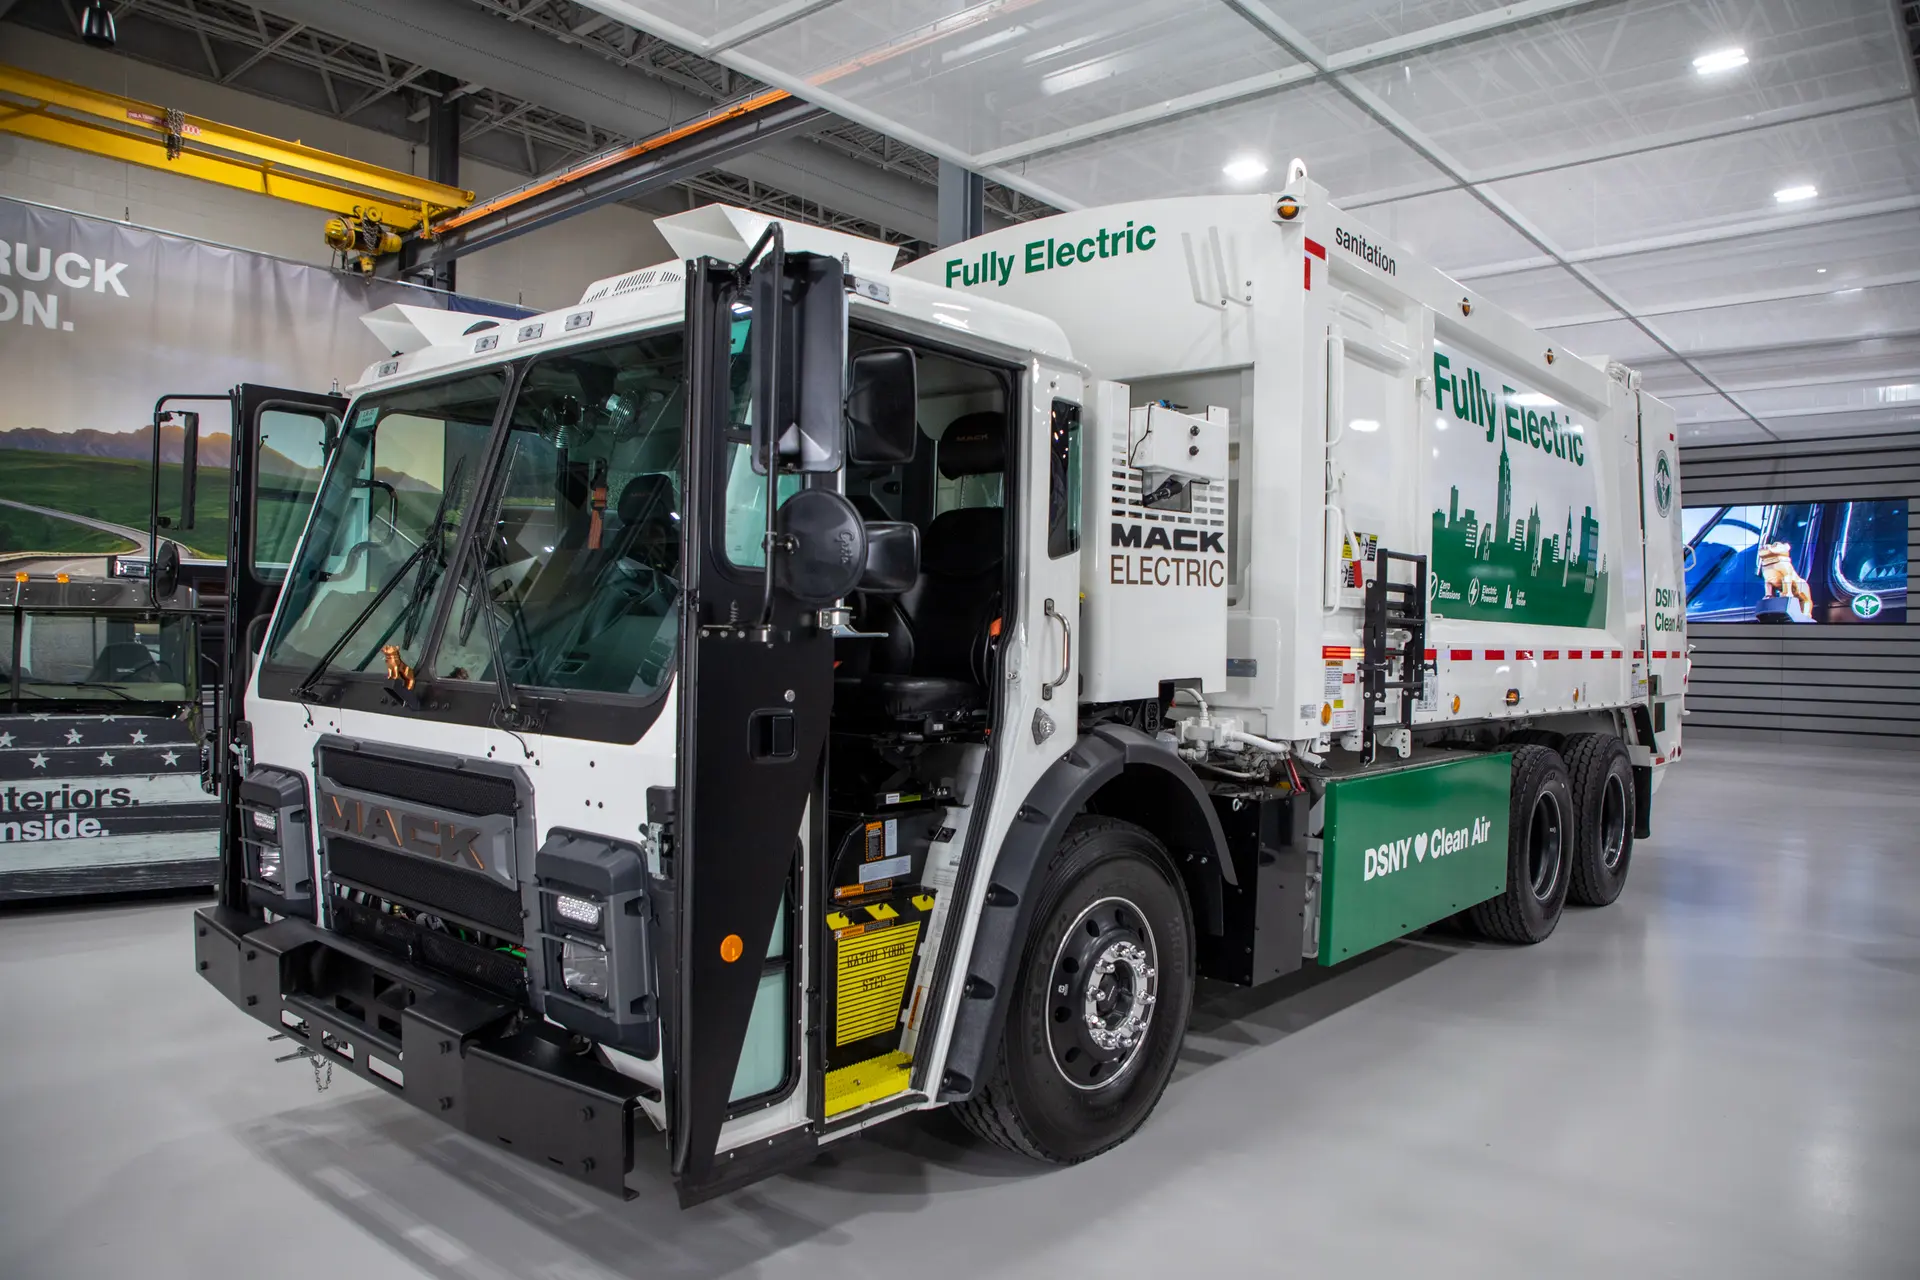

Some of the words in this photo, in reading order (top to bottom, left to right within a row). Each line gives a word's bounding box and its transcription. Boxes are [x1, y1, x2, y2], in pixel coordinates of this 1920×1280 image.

[945, 250, 1015, 288] Fully
[1025, 220, 1157, 275] Electric
[1335, 227, 1396, 277] sanitation
[1433, 351, 1497, 443] Fully
[1502, 384, 1585, 467] Electric
[1110, 522, 1225, 554] MACK
[1110, 553, 1225, 588] ELECTRIC
[1438, 588, 1461, 600] Emissions
[1655, 588, 1677, 608] DSNY
[1655, 612, 1676, 632] Clean
[0, 784, 140, 812] teriors.
[322, 793, 485, 870] MACK
[1363, 836, 1413, 881] DSNY
[1430, 827, 1469, 859] Clean
[1471, 815, 1491, 846] Air
